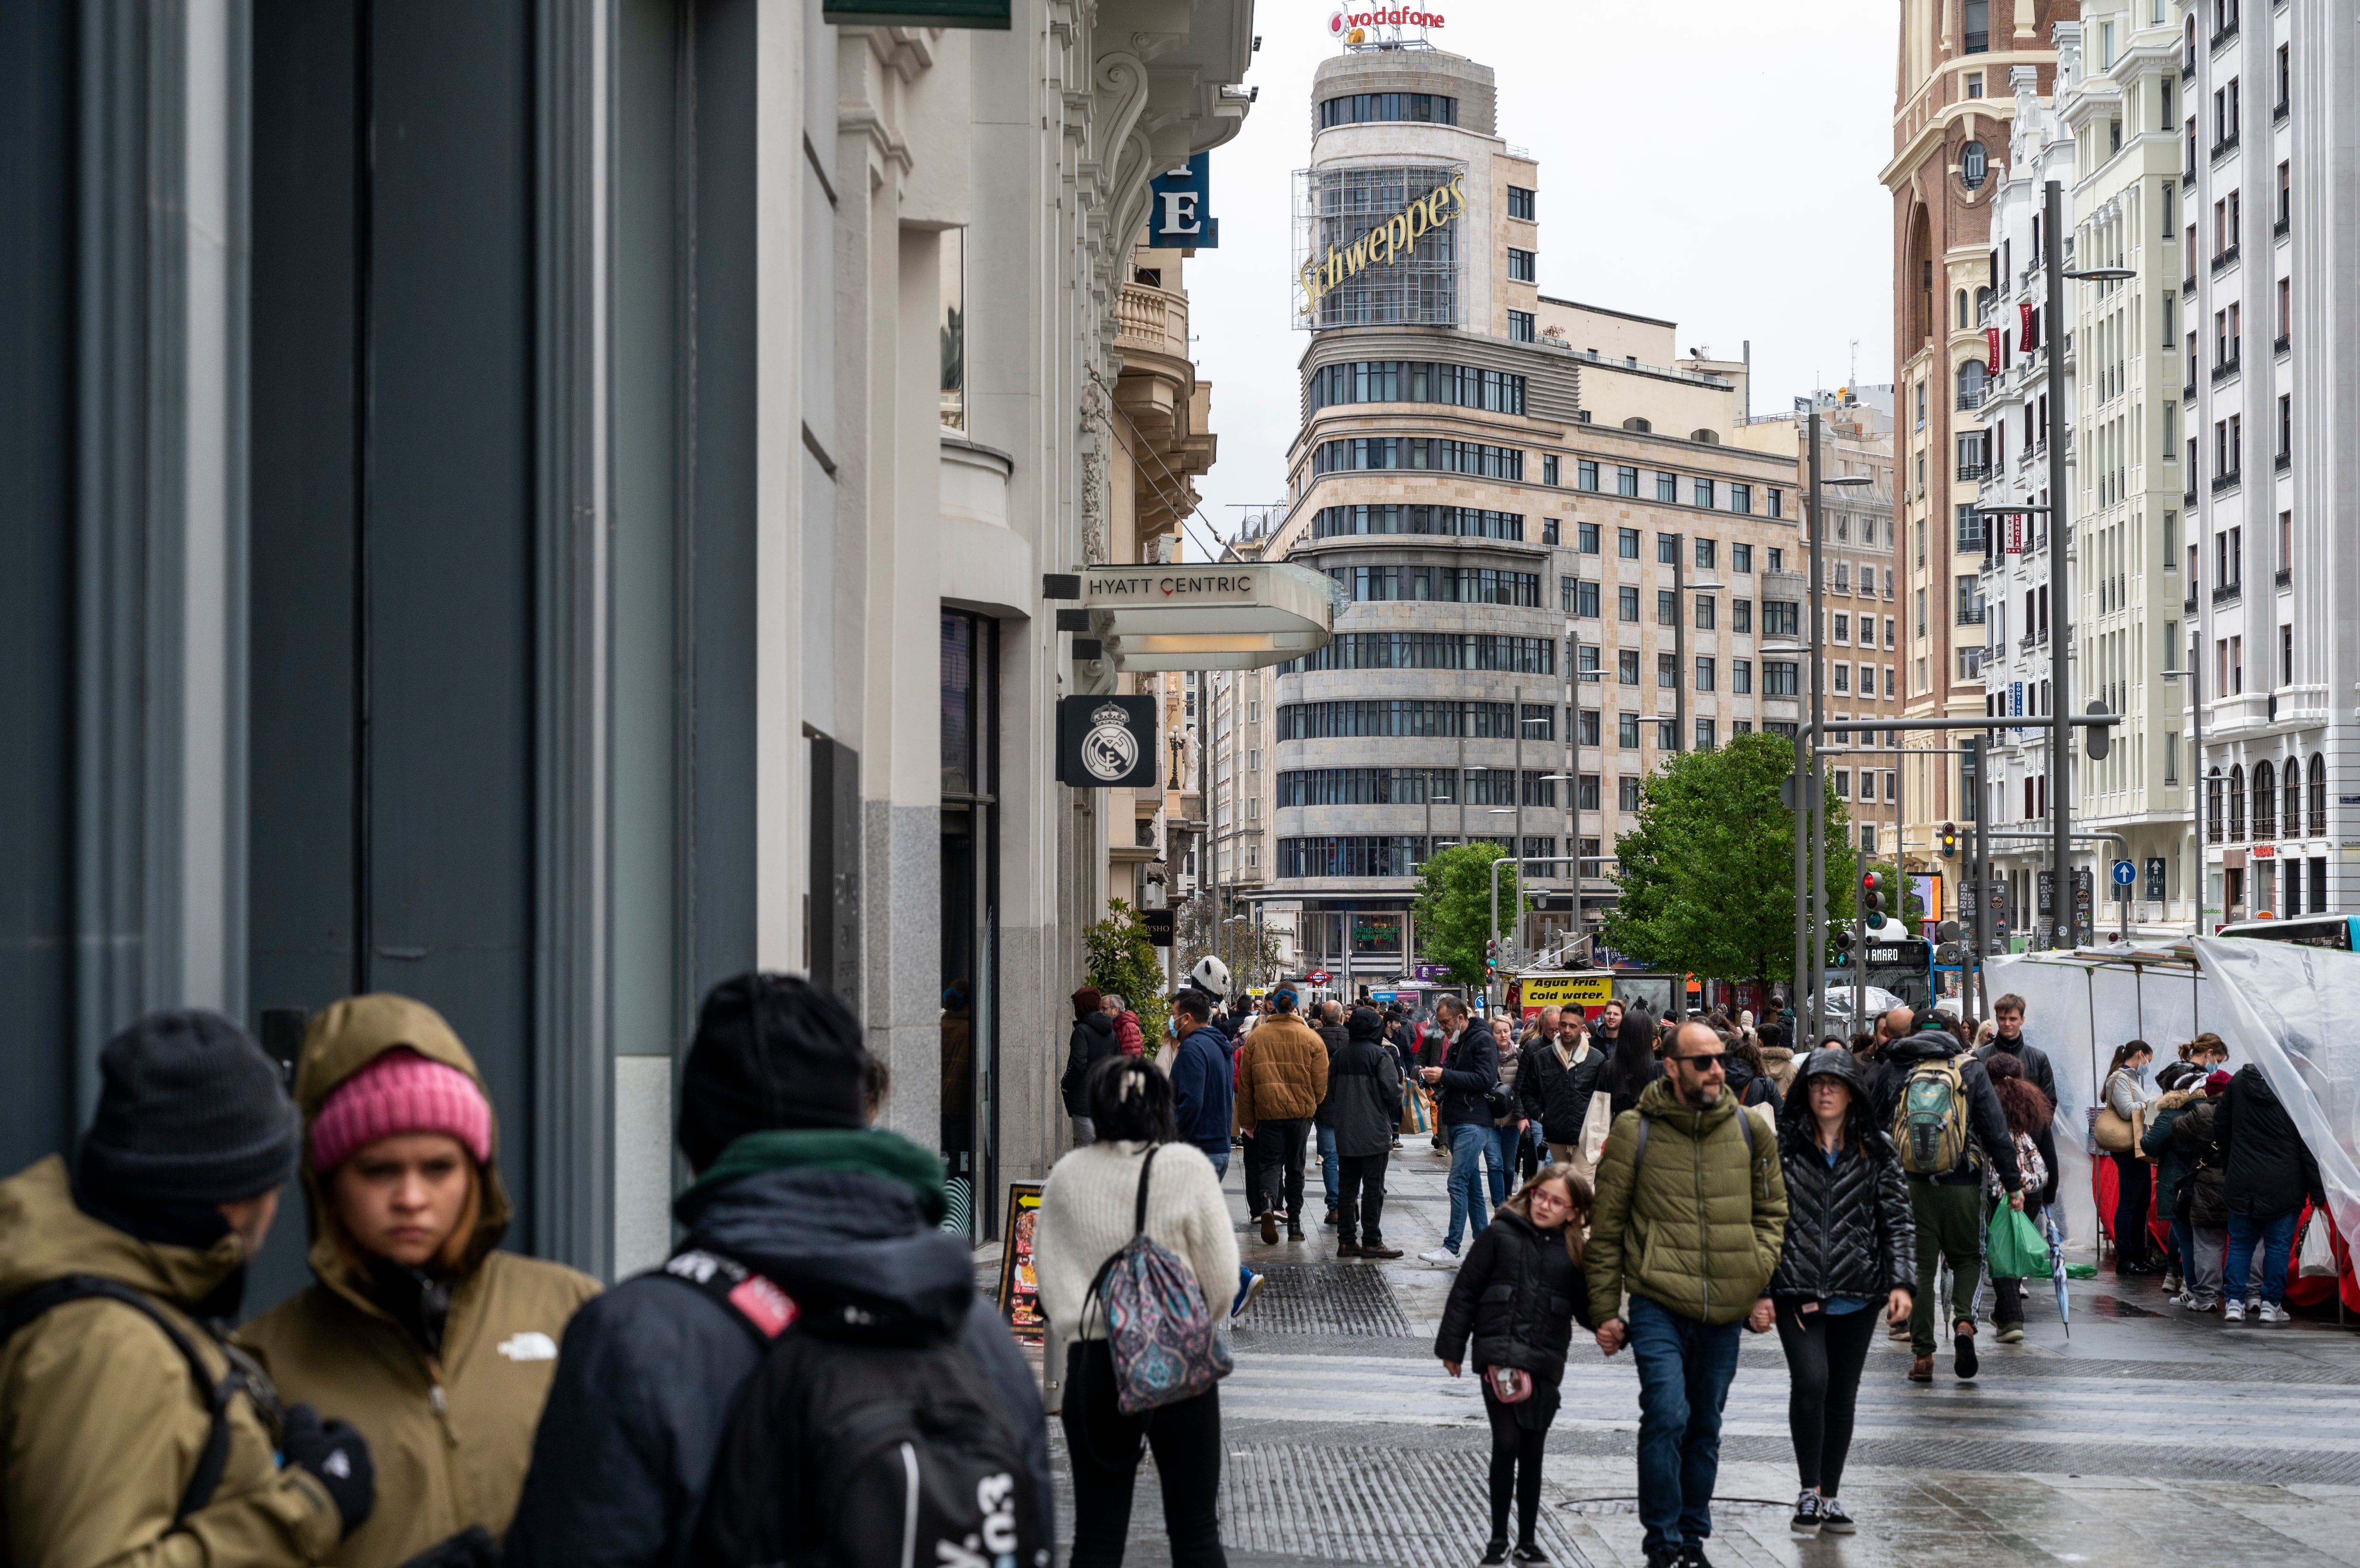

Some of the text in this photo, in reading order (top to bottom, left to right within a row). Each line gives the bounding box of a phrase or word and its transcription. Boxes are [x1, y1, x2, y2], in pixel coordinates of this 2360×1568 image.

[1348, 6, 1444, 27] vodafone
[1299, 173, 1466, 316] Schweppes
[1090, 577, 1250, 595] HYATT CENTRIC
[2148, 876, 2163, 884] ella
[2040, 940, 2048, 948] 54
[1871, 949, 1898, 961] AMARO
[1534, 979, 1568, 987] Agua
[1530, 991, 1604, 1000] Cold water.
